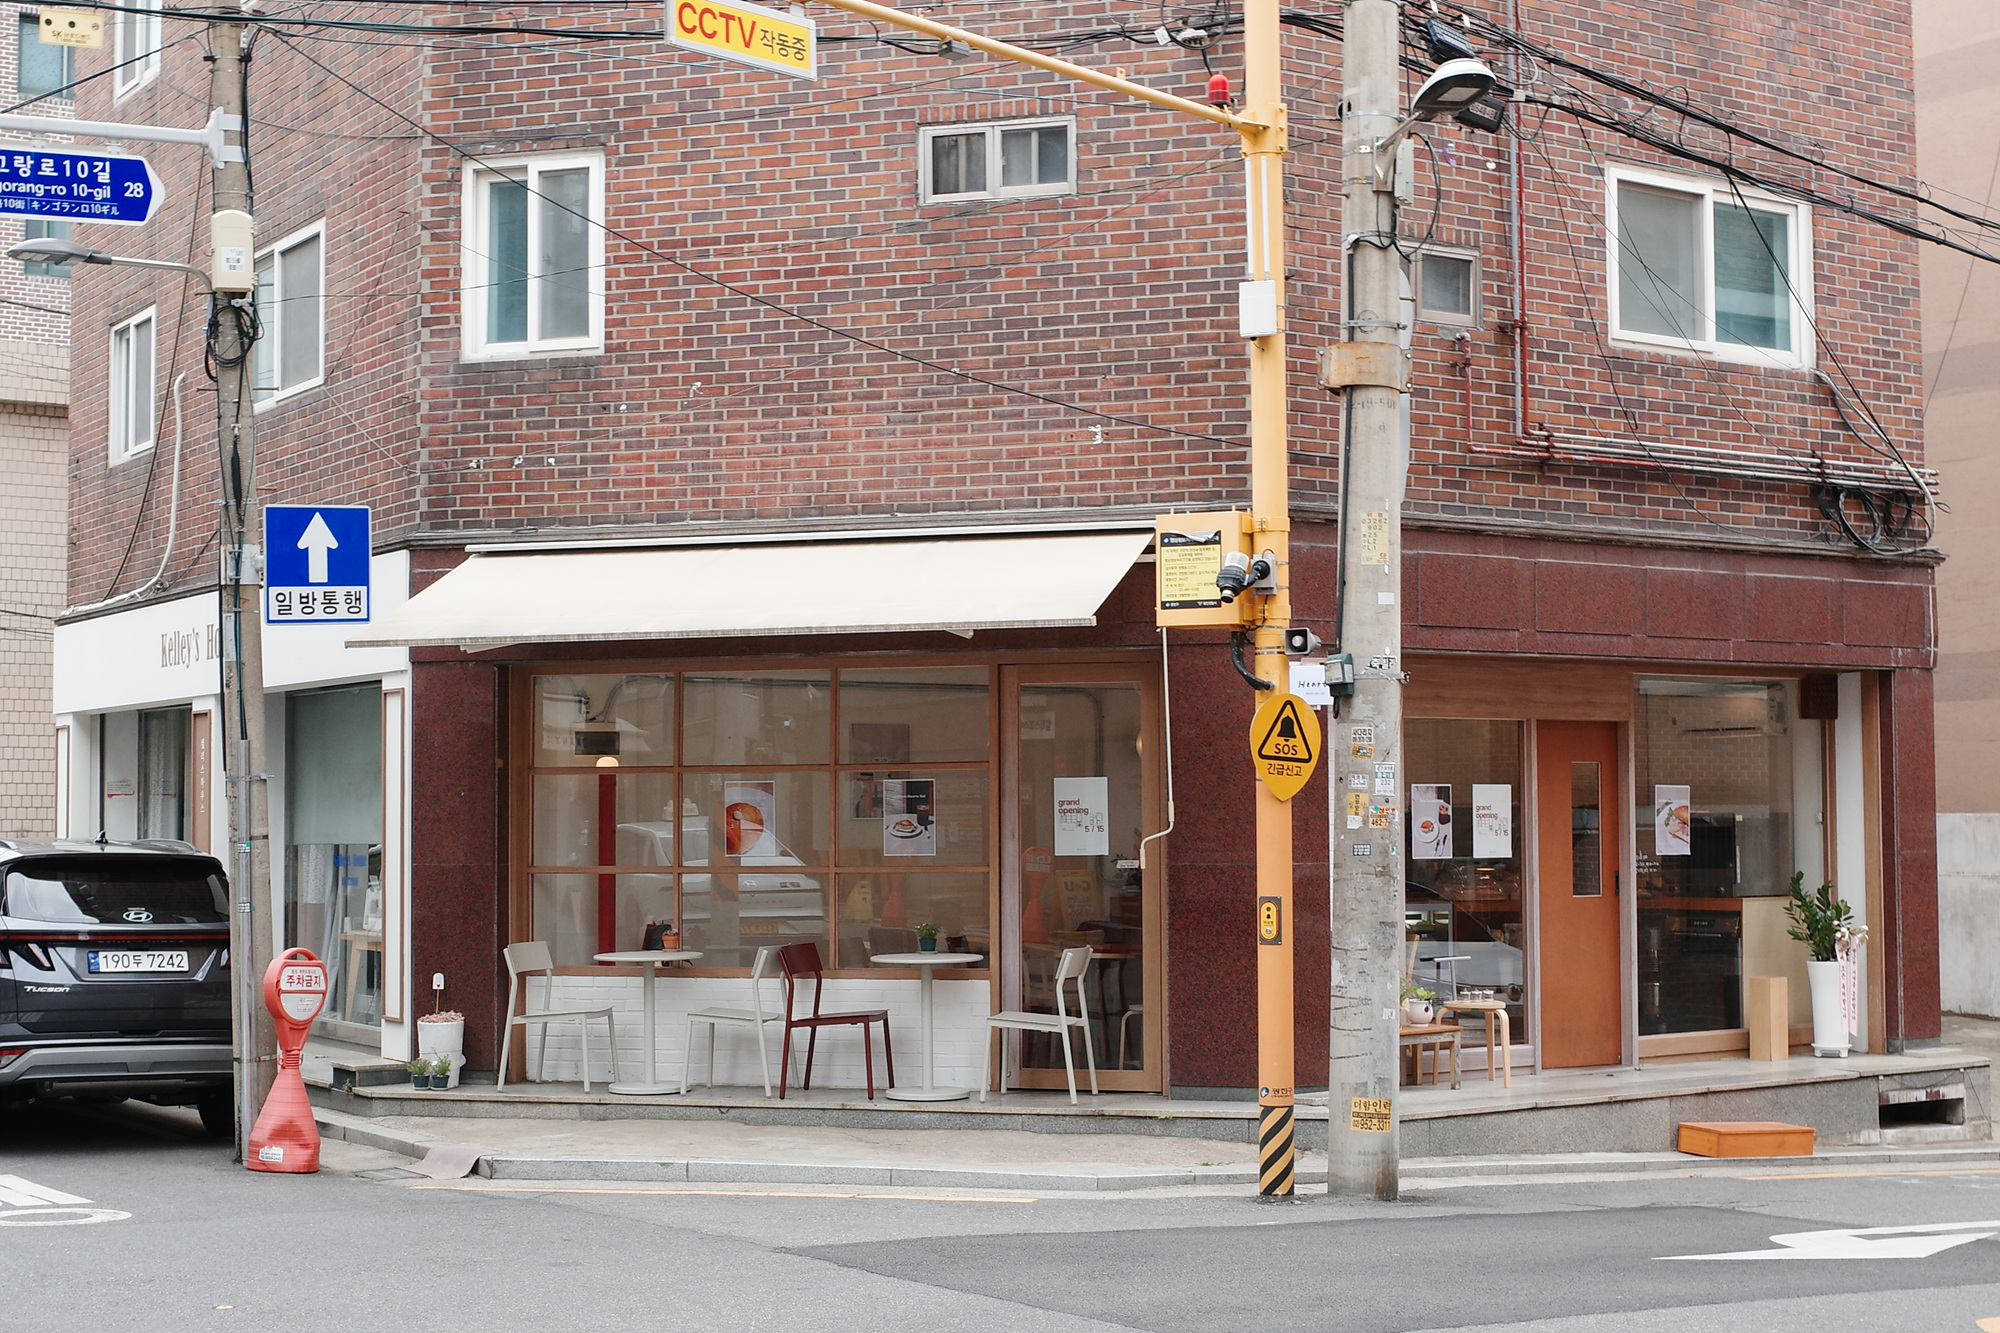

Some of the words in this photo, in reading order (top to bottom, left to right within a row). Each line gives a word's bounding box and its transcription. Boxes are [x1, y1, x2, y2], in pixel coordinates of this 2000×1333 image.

[678, 2, 756, 48] CCTV
[760, 28, 806, 61] 작동중
[0, 181, 67, 197] orang-ro
[72, 183, 111, 200] 10-gil
[124, 182, 144, 198] 28
[275, 590, 362, 616] 일방통행
[161, 627, 200, 669] Kelley's
[1274, 743, 1298, 756] SOS
[1267, 763, 1302, 777] 긴급신고
[1058, 799, 1080, 807] grand
[1476, 804, 1491, 812] grand
[1058, 807, 1089, 816] opening
[102, 953, 143, 969] 190두
[147, 953, 185, 969] 7242
[286, 974, 321, 988] 주차금지
